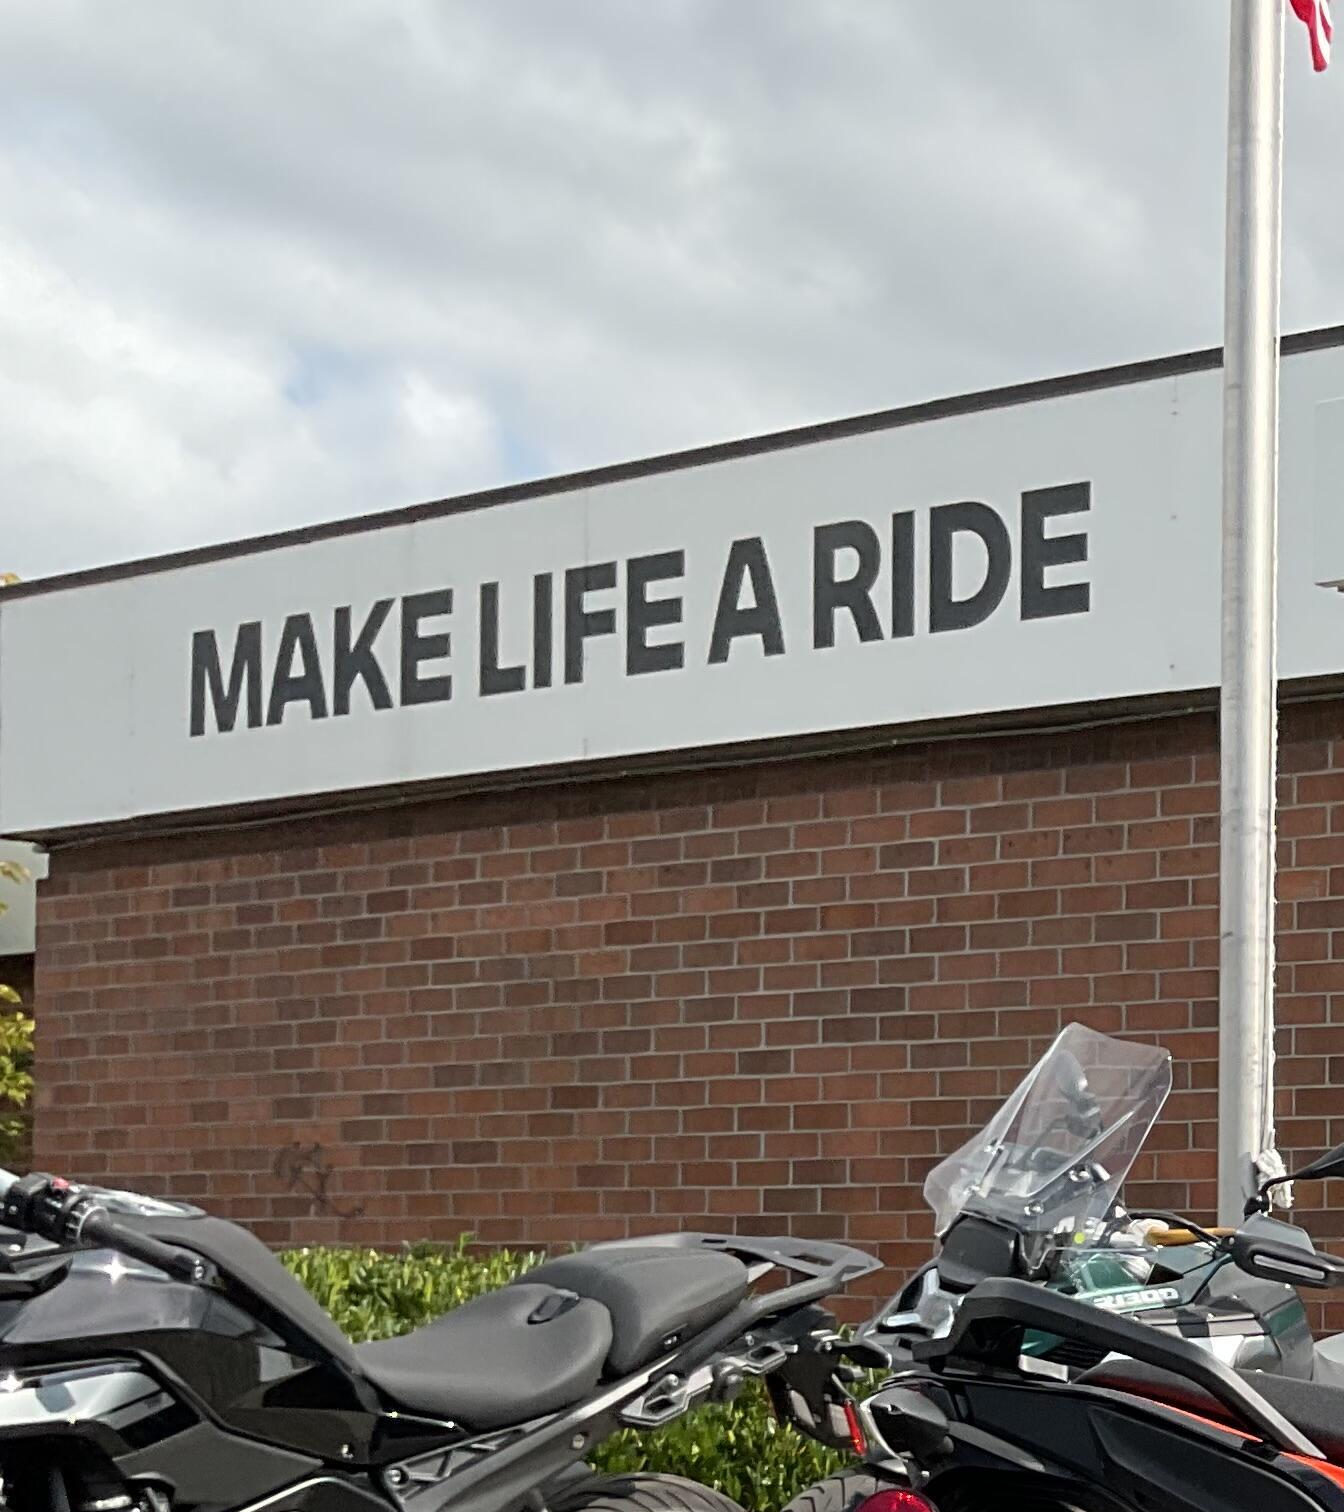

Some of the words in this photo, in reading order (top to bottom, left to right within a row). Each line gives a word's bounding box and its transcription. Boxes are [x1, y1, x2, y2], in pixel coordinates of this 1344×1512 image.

[189, 587, 454, 738] MAKE
[476, 548, 687, 698] LIFE
[707, 536, 786, 664] A
[812, 479, 1093, 650] RIDE
